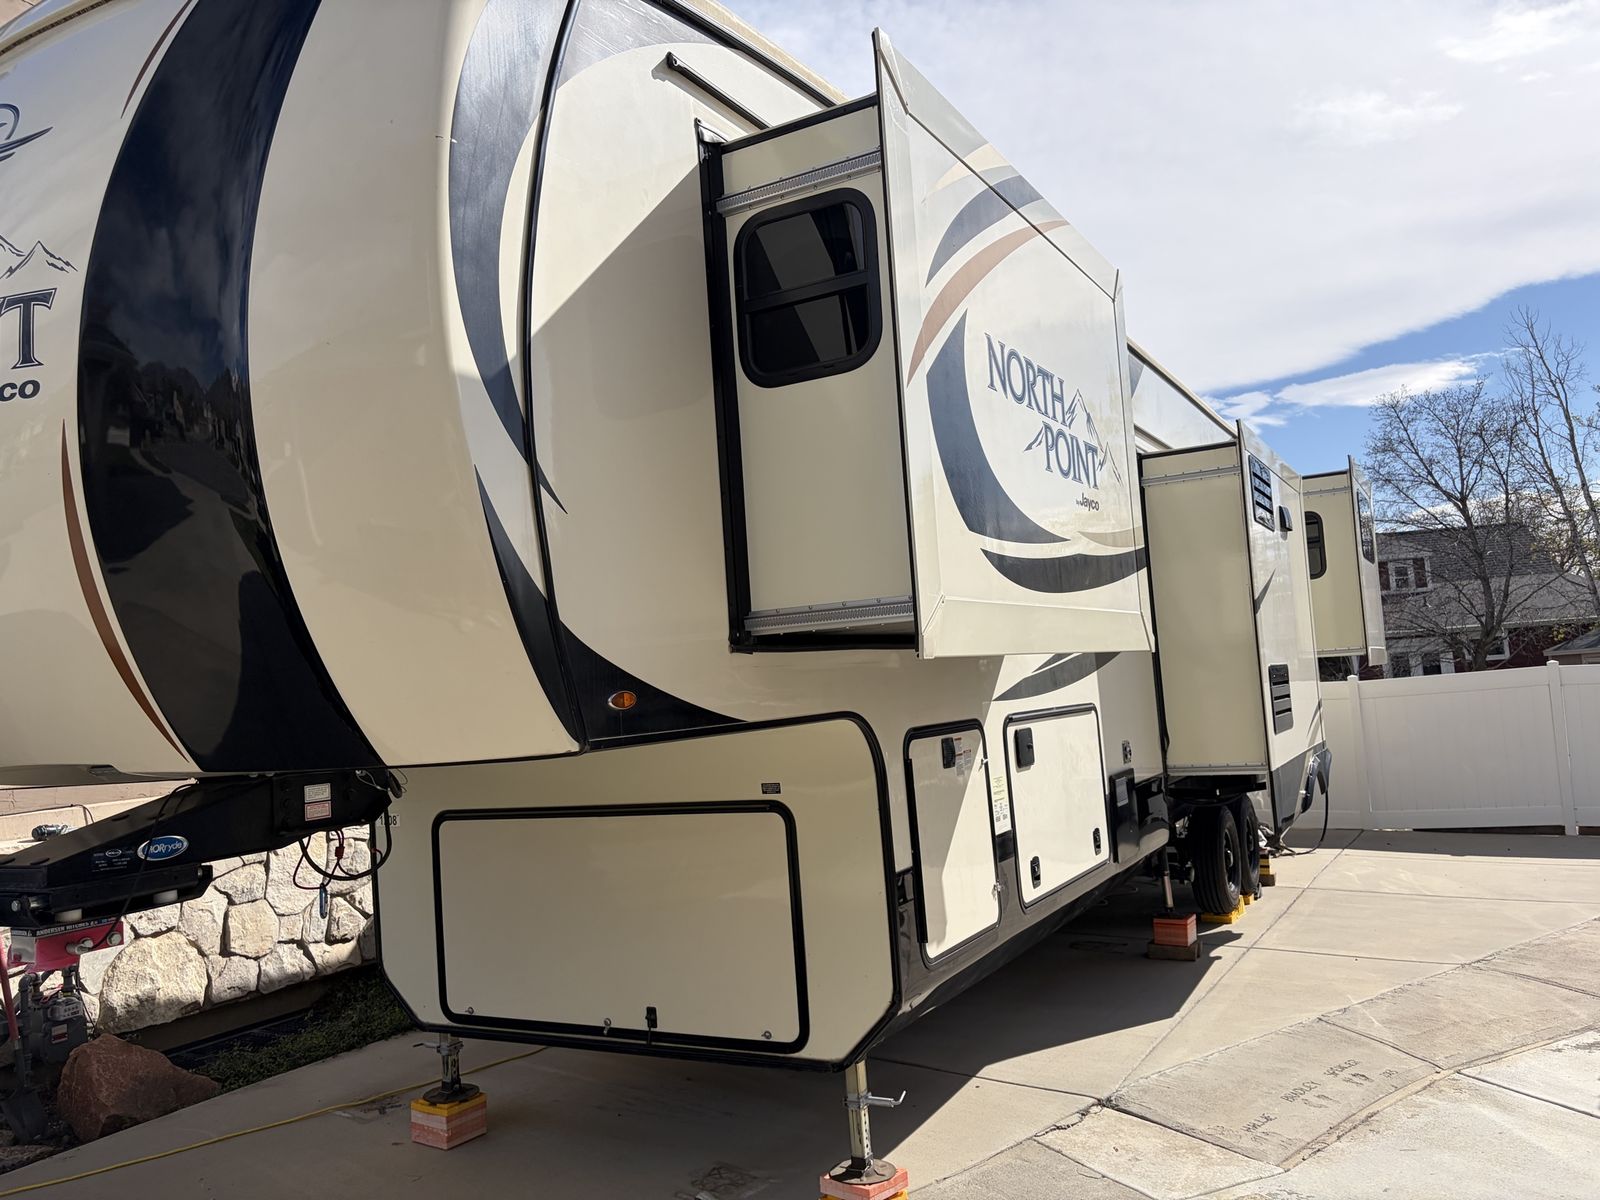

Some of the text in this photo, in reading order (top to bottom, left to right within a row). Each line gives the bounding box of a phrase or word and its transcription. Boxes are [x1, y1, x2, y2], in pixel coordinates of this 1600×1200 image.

[984, 332, 1068, 428] NORTH
[1042, 420, 1099, 490] POINT
[1080, 492, 1100, 512] Jayco
